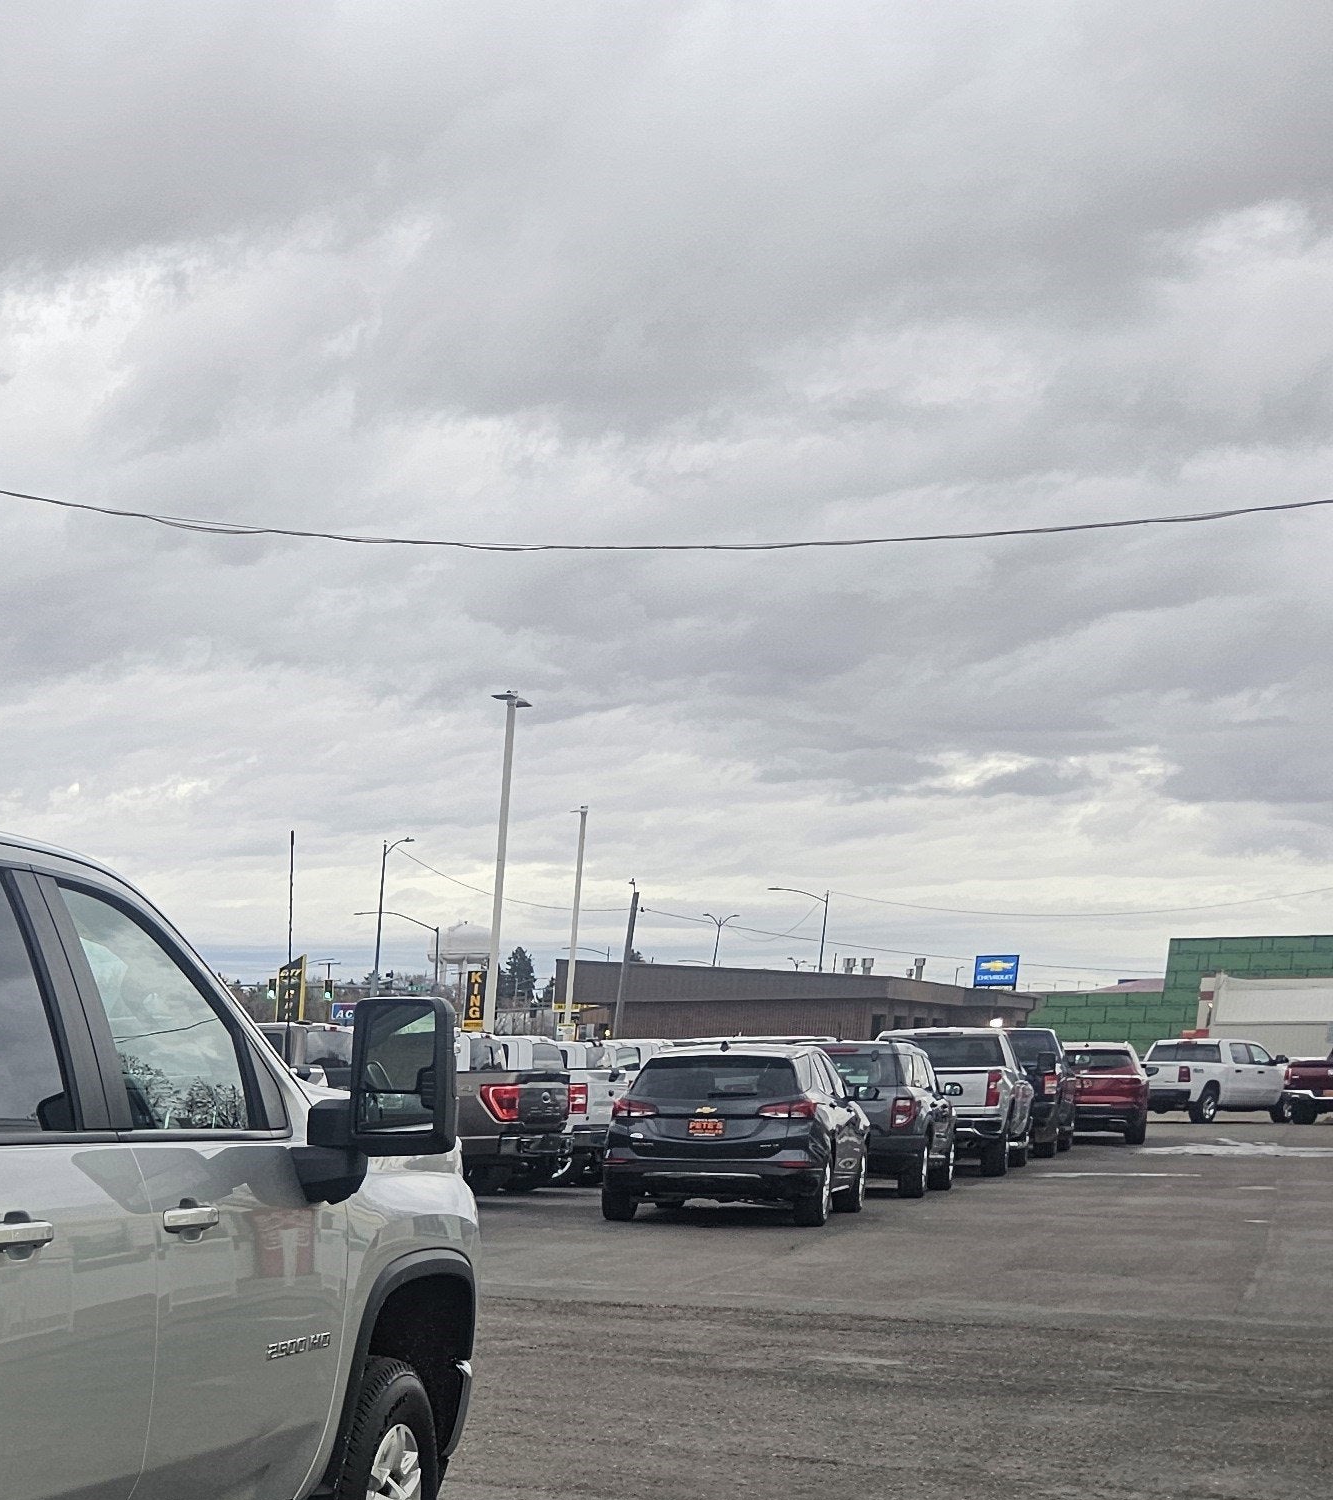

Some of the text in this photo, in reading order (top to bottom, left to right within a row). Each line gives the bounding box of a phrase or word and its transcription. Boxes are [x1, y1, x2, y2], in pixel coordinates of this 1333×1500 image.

[468, 972, 482, 1019] KING
[266, 1332, 331, 1360] 2500 HD
